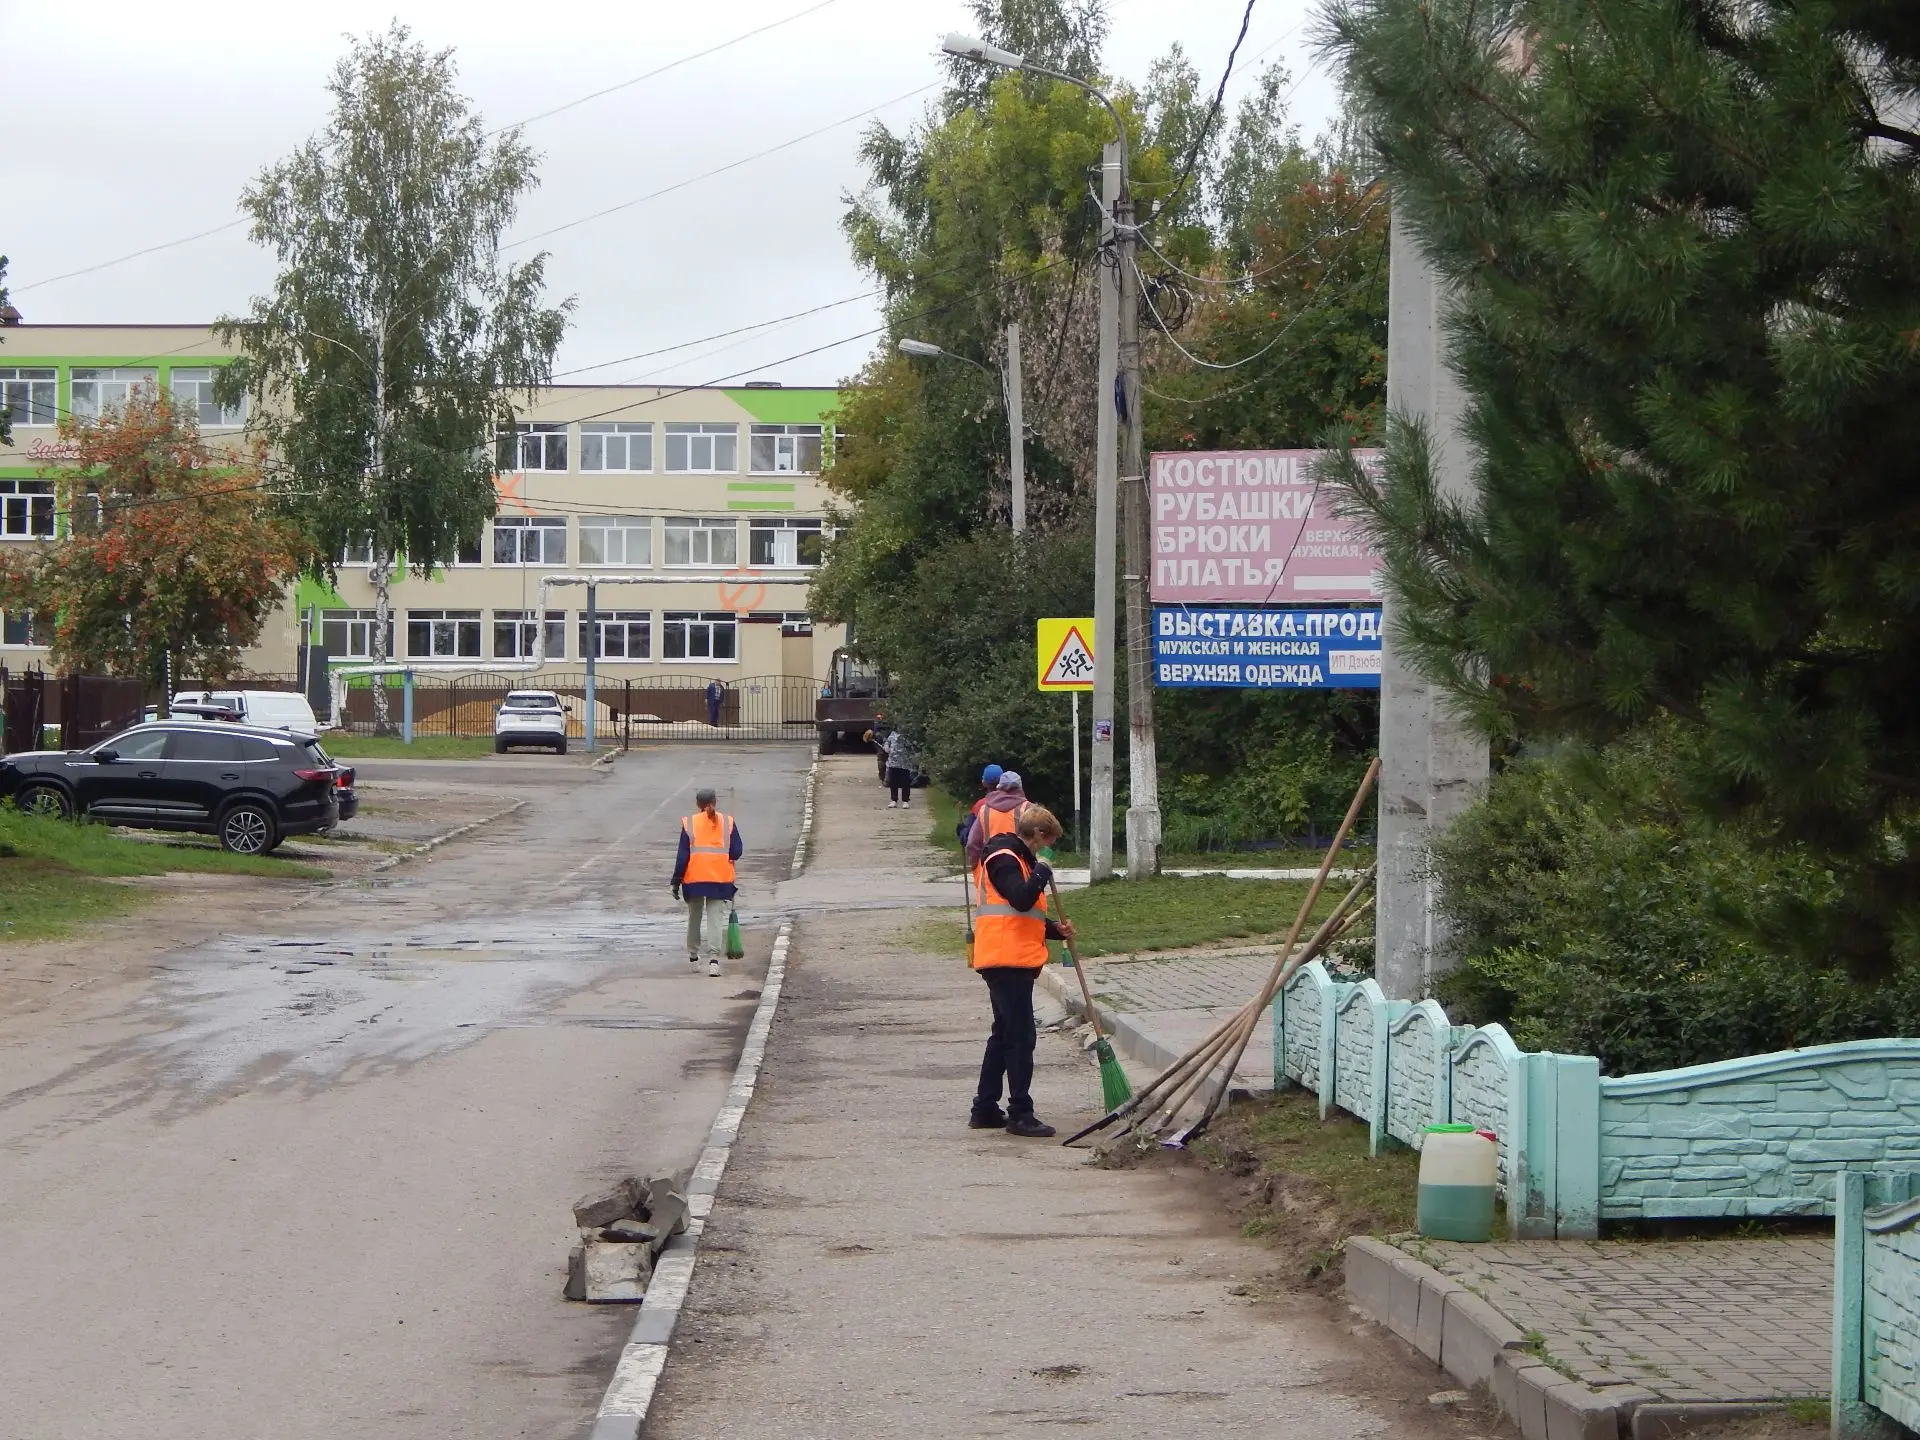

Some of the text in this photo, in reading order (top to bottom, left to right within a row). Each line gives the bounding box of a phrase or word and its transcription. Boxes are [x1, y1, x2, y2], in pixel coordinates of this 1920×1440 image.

[1157, 491, 1315, 520] РУБАШКИ
[1157, 525, 1270, 553] БРЮКИ
[1157, 558, 1284, 586] ПЛАТЬЯ
[1159, 641, 1320, 656] МУЖСКАЯ И ЖЕНСКАЯ
[1331, 654, 1346, 669] ИП
[1159, 664, 1324, 687] ВЕРХНЯЯ ОДЕЖДА
